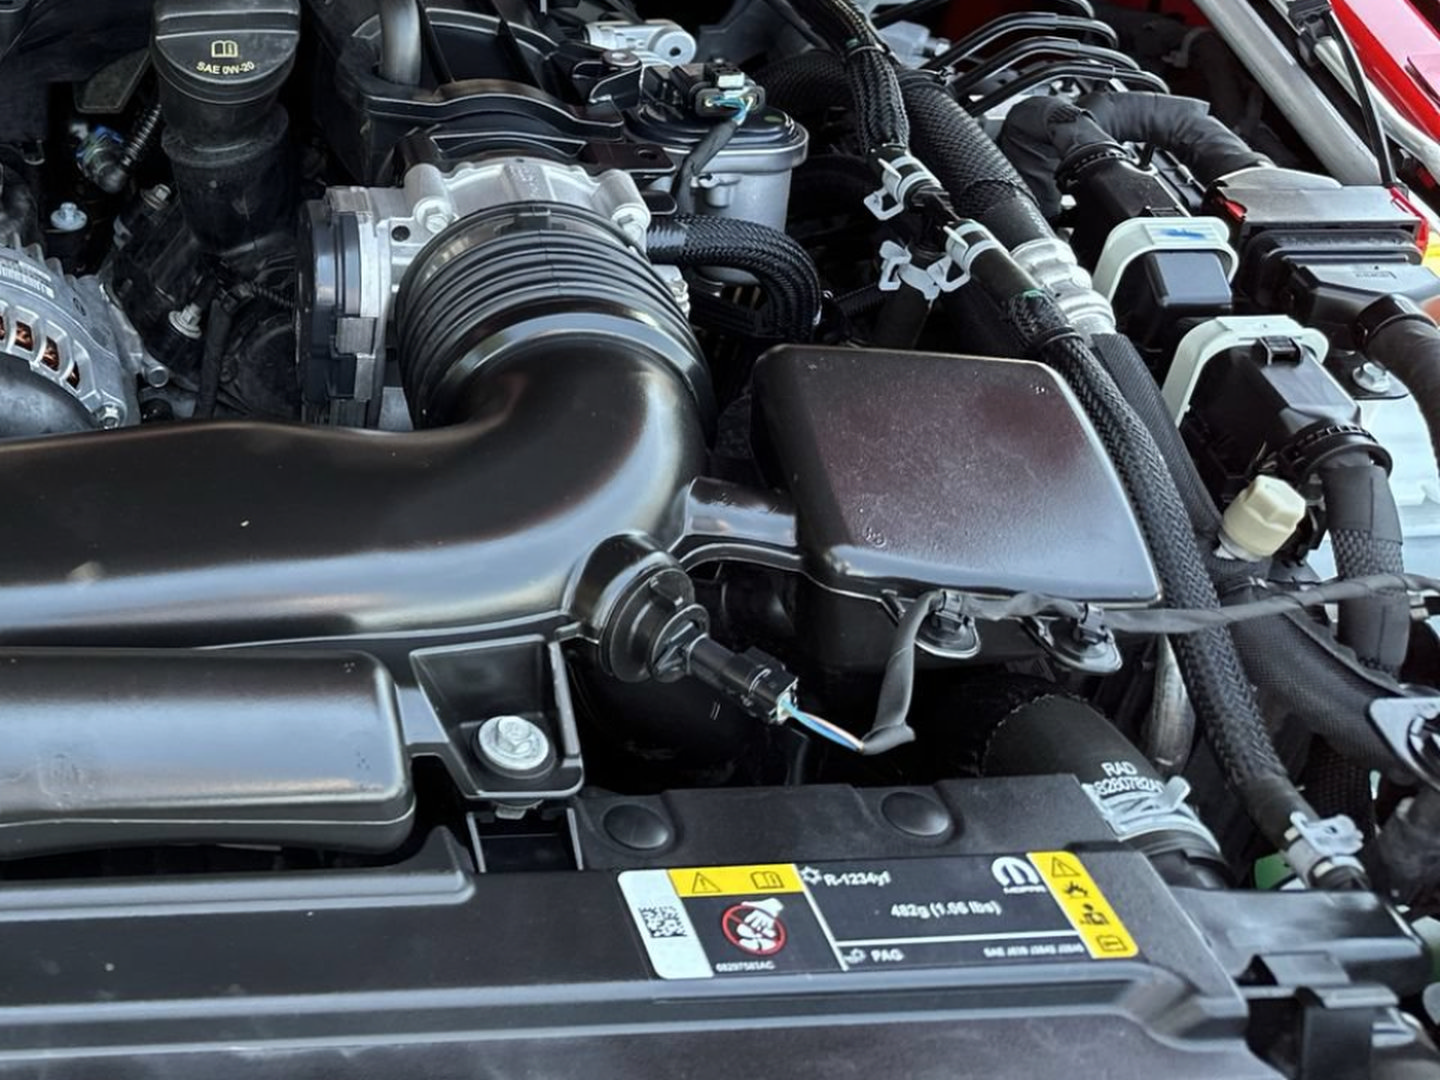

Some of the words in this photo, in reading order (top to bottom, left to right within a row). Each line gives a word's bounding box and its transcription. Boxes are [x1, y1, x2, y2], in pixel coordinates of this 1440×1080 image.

[196, 60, 220, 75] SAE
[222, 60, 255, 75] 0W-20
[1101, 761, 1137, 777] RAD
[823, 871, 891, 887] R-1234yf
[870, 948, 905, 962] PAG
